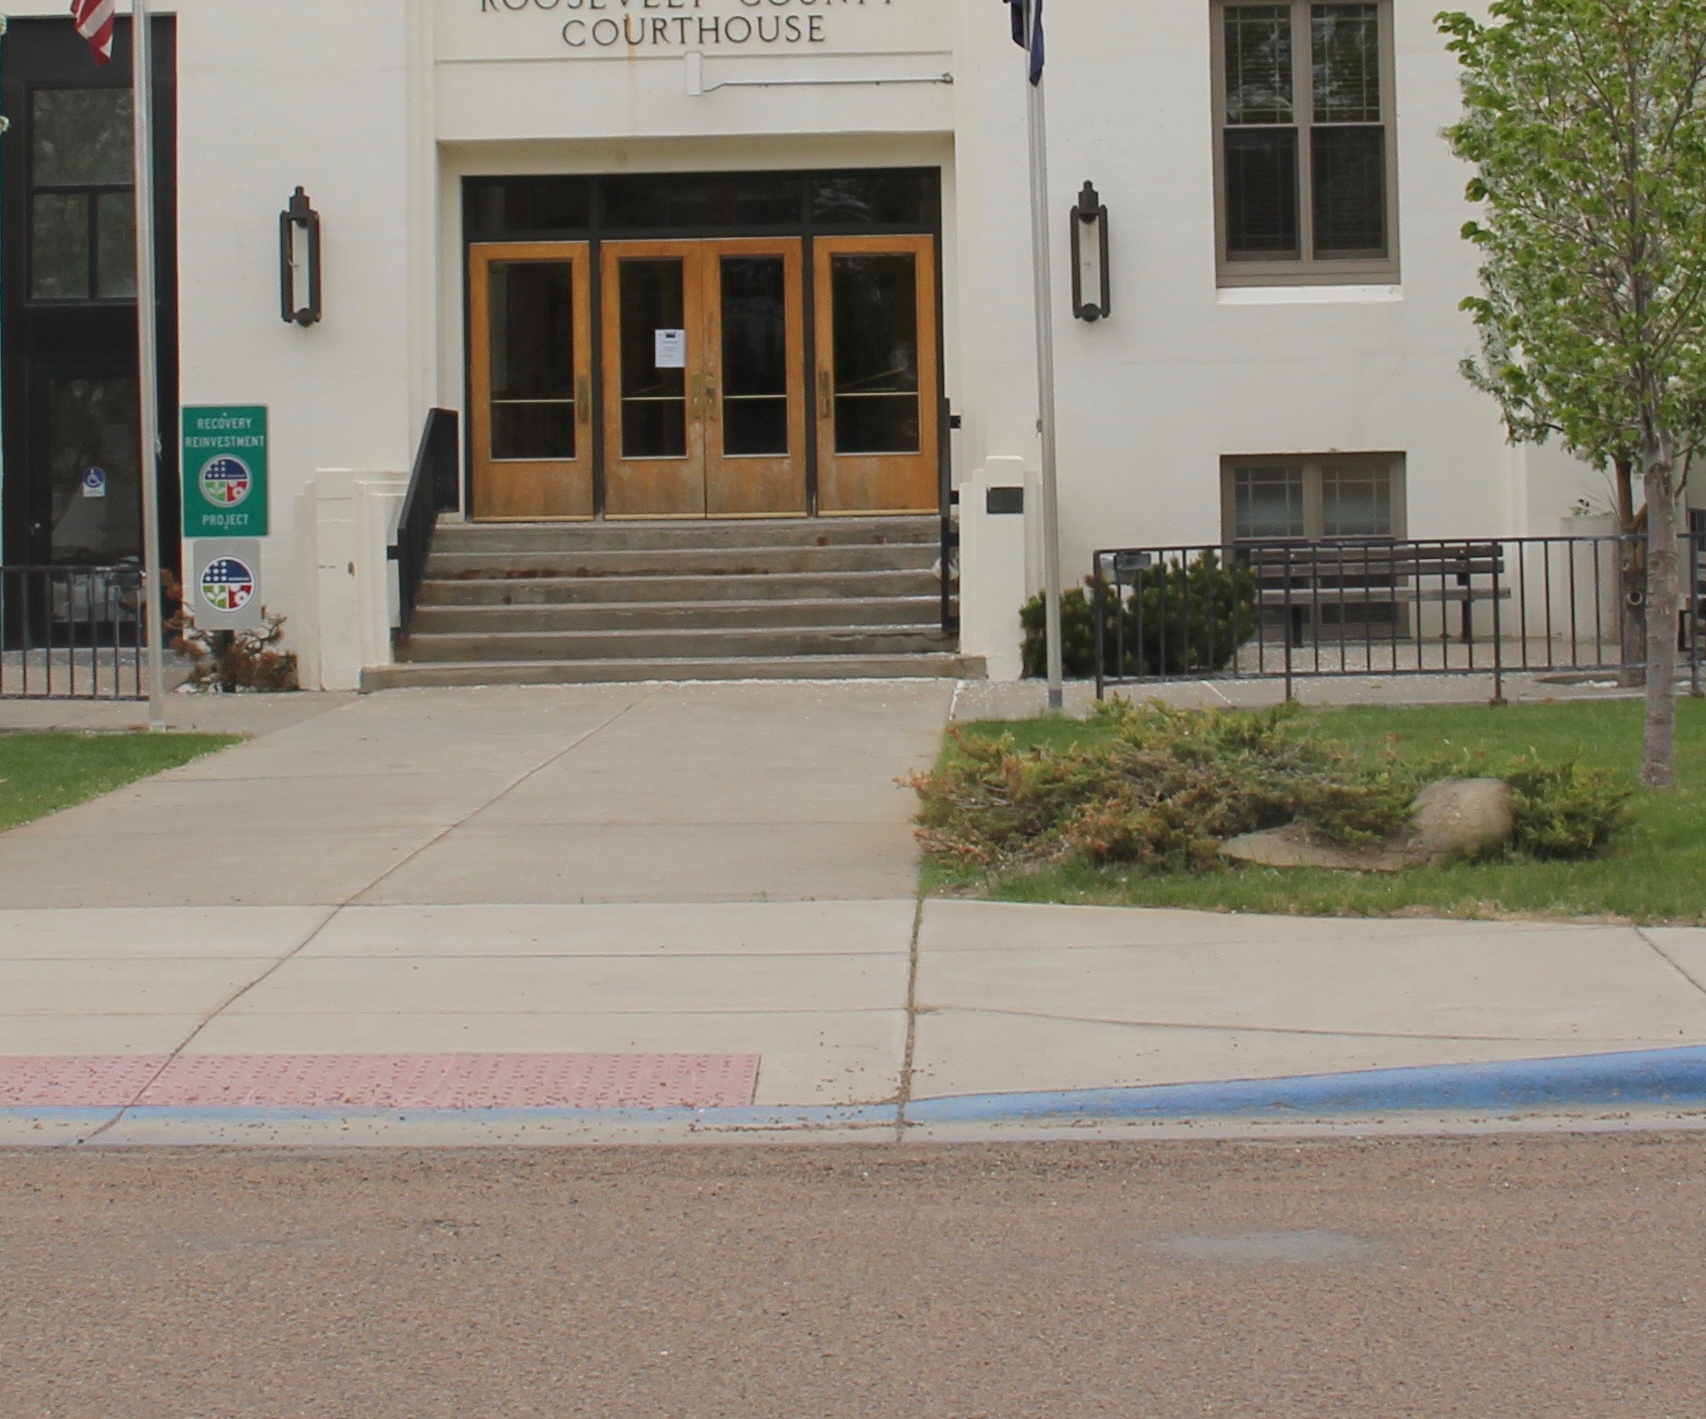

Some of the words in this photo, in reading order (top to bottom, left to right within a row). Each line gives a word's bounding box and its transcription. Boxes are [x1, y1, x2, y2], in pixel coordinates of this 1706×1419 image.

[562, 15, 825, 46] COURTHOUSE
[197, 418, 252, 429] RECOVERY
[185, 436, 265, 448] REINVESTMENT
[202, 514, 249, 526] PROJECT
